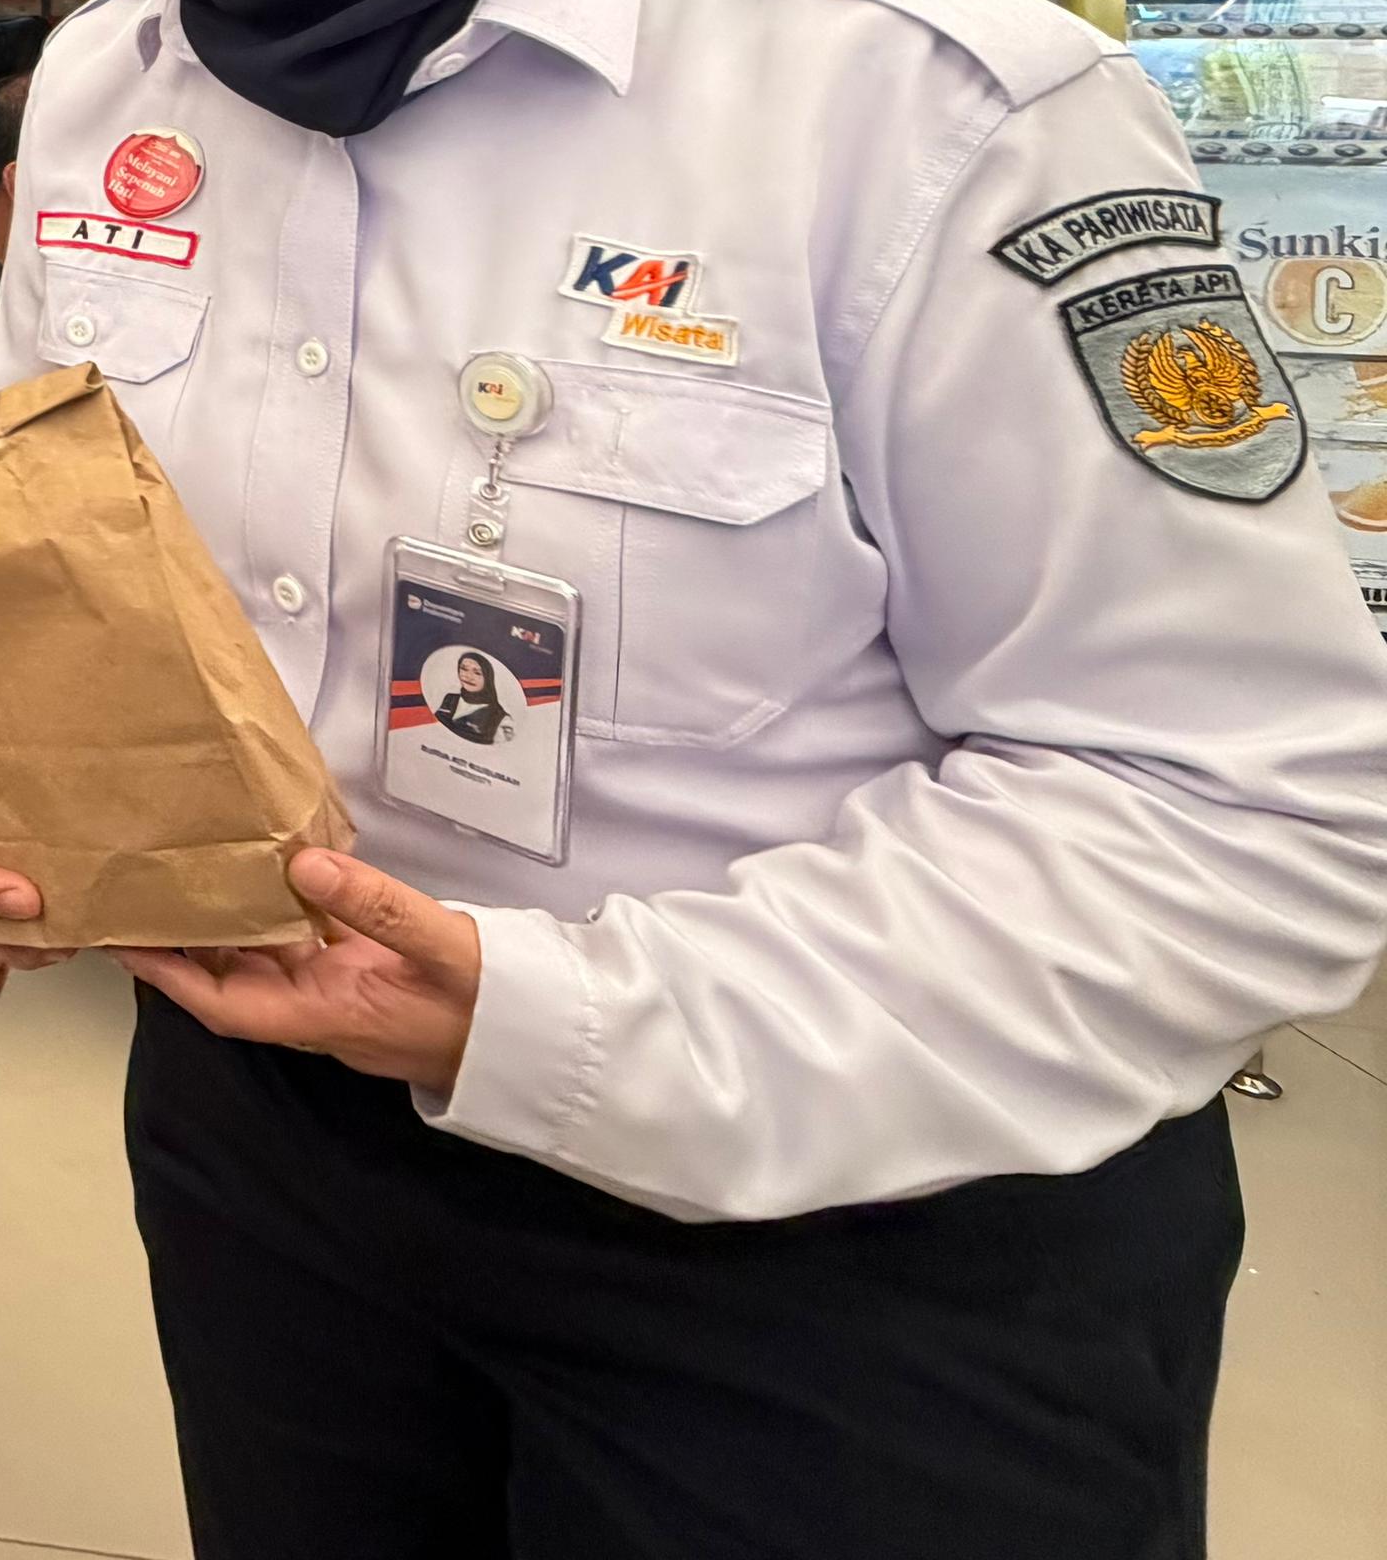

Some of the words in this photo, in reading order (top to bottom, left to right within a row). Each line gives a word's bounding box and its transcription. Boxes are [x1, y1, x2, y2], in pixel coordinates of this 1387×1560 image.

[107, 179, 135, 200] Hati
[116, 165, 166, 199] Sepenuh
[126, 152, 179, 187] Melayani
[71, 219, 145, 250] ATI
[1014, 231, 1074, 274] KA
[1062, 199, 1210, 250] PARIWISATA
[573, 245, 690, 308] KAI
[1076, 277, 1187, 324] KERETA
[1193, 272, 1235, 295] API
[1312, 265, 1355, 335] C
